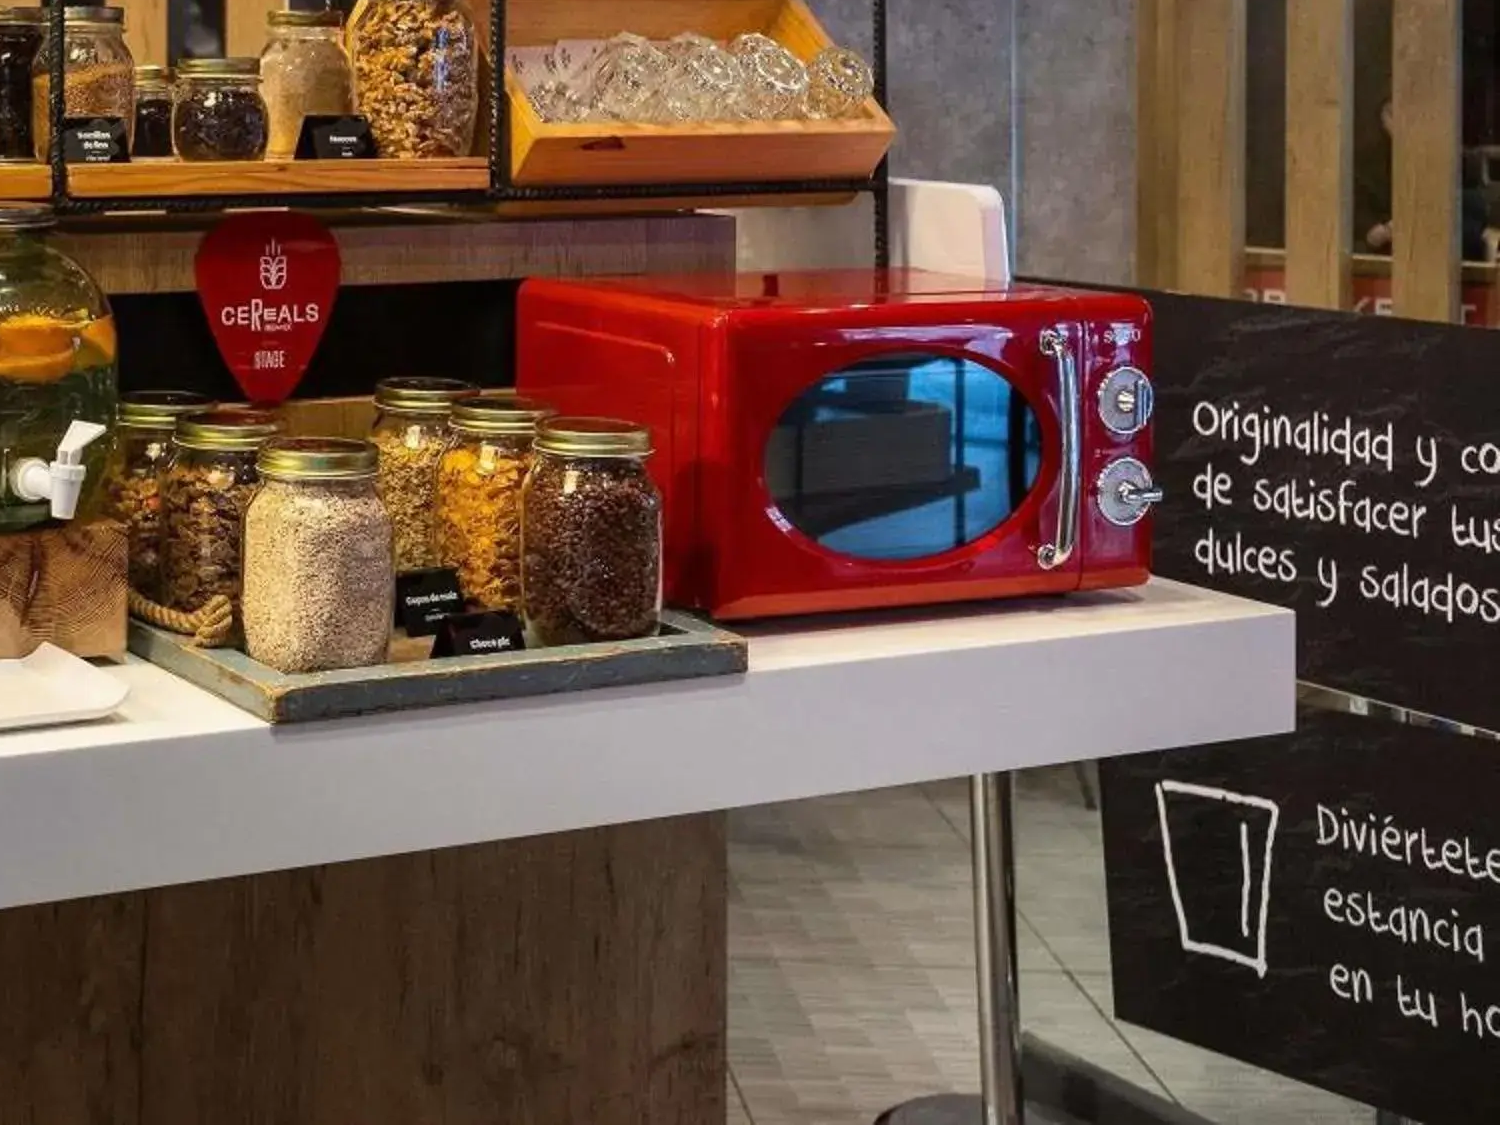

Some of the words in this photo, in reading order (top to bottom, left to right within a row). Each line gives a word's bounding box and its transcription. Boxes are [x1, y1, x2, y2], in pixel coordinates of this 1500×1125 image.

[221, 298, 320, 331] CEREALS
[1193, 401, 1393, 472] Originalidad
[1415, 435, 1437, 487] y
[1193, 463, 1233, 509] de
[1253, 479, 1427, 538] satisfacer
[1195, 527, 1297, 581] dulces
[1316, 557, 1338, 607] y
[1360, 562, 1500, 623] salados
[1316, 803, 1500, 883] Diviértete
[1324, 887, 1484, 963] estancia
[1330, 963, 1373, 1004] en
[1397, 974, 1439, 1028] tu
